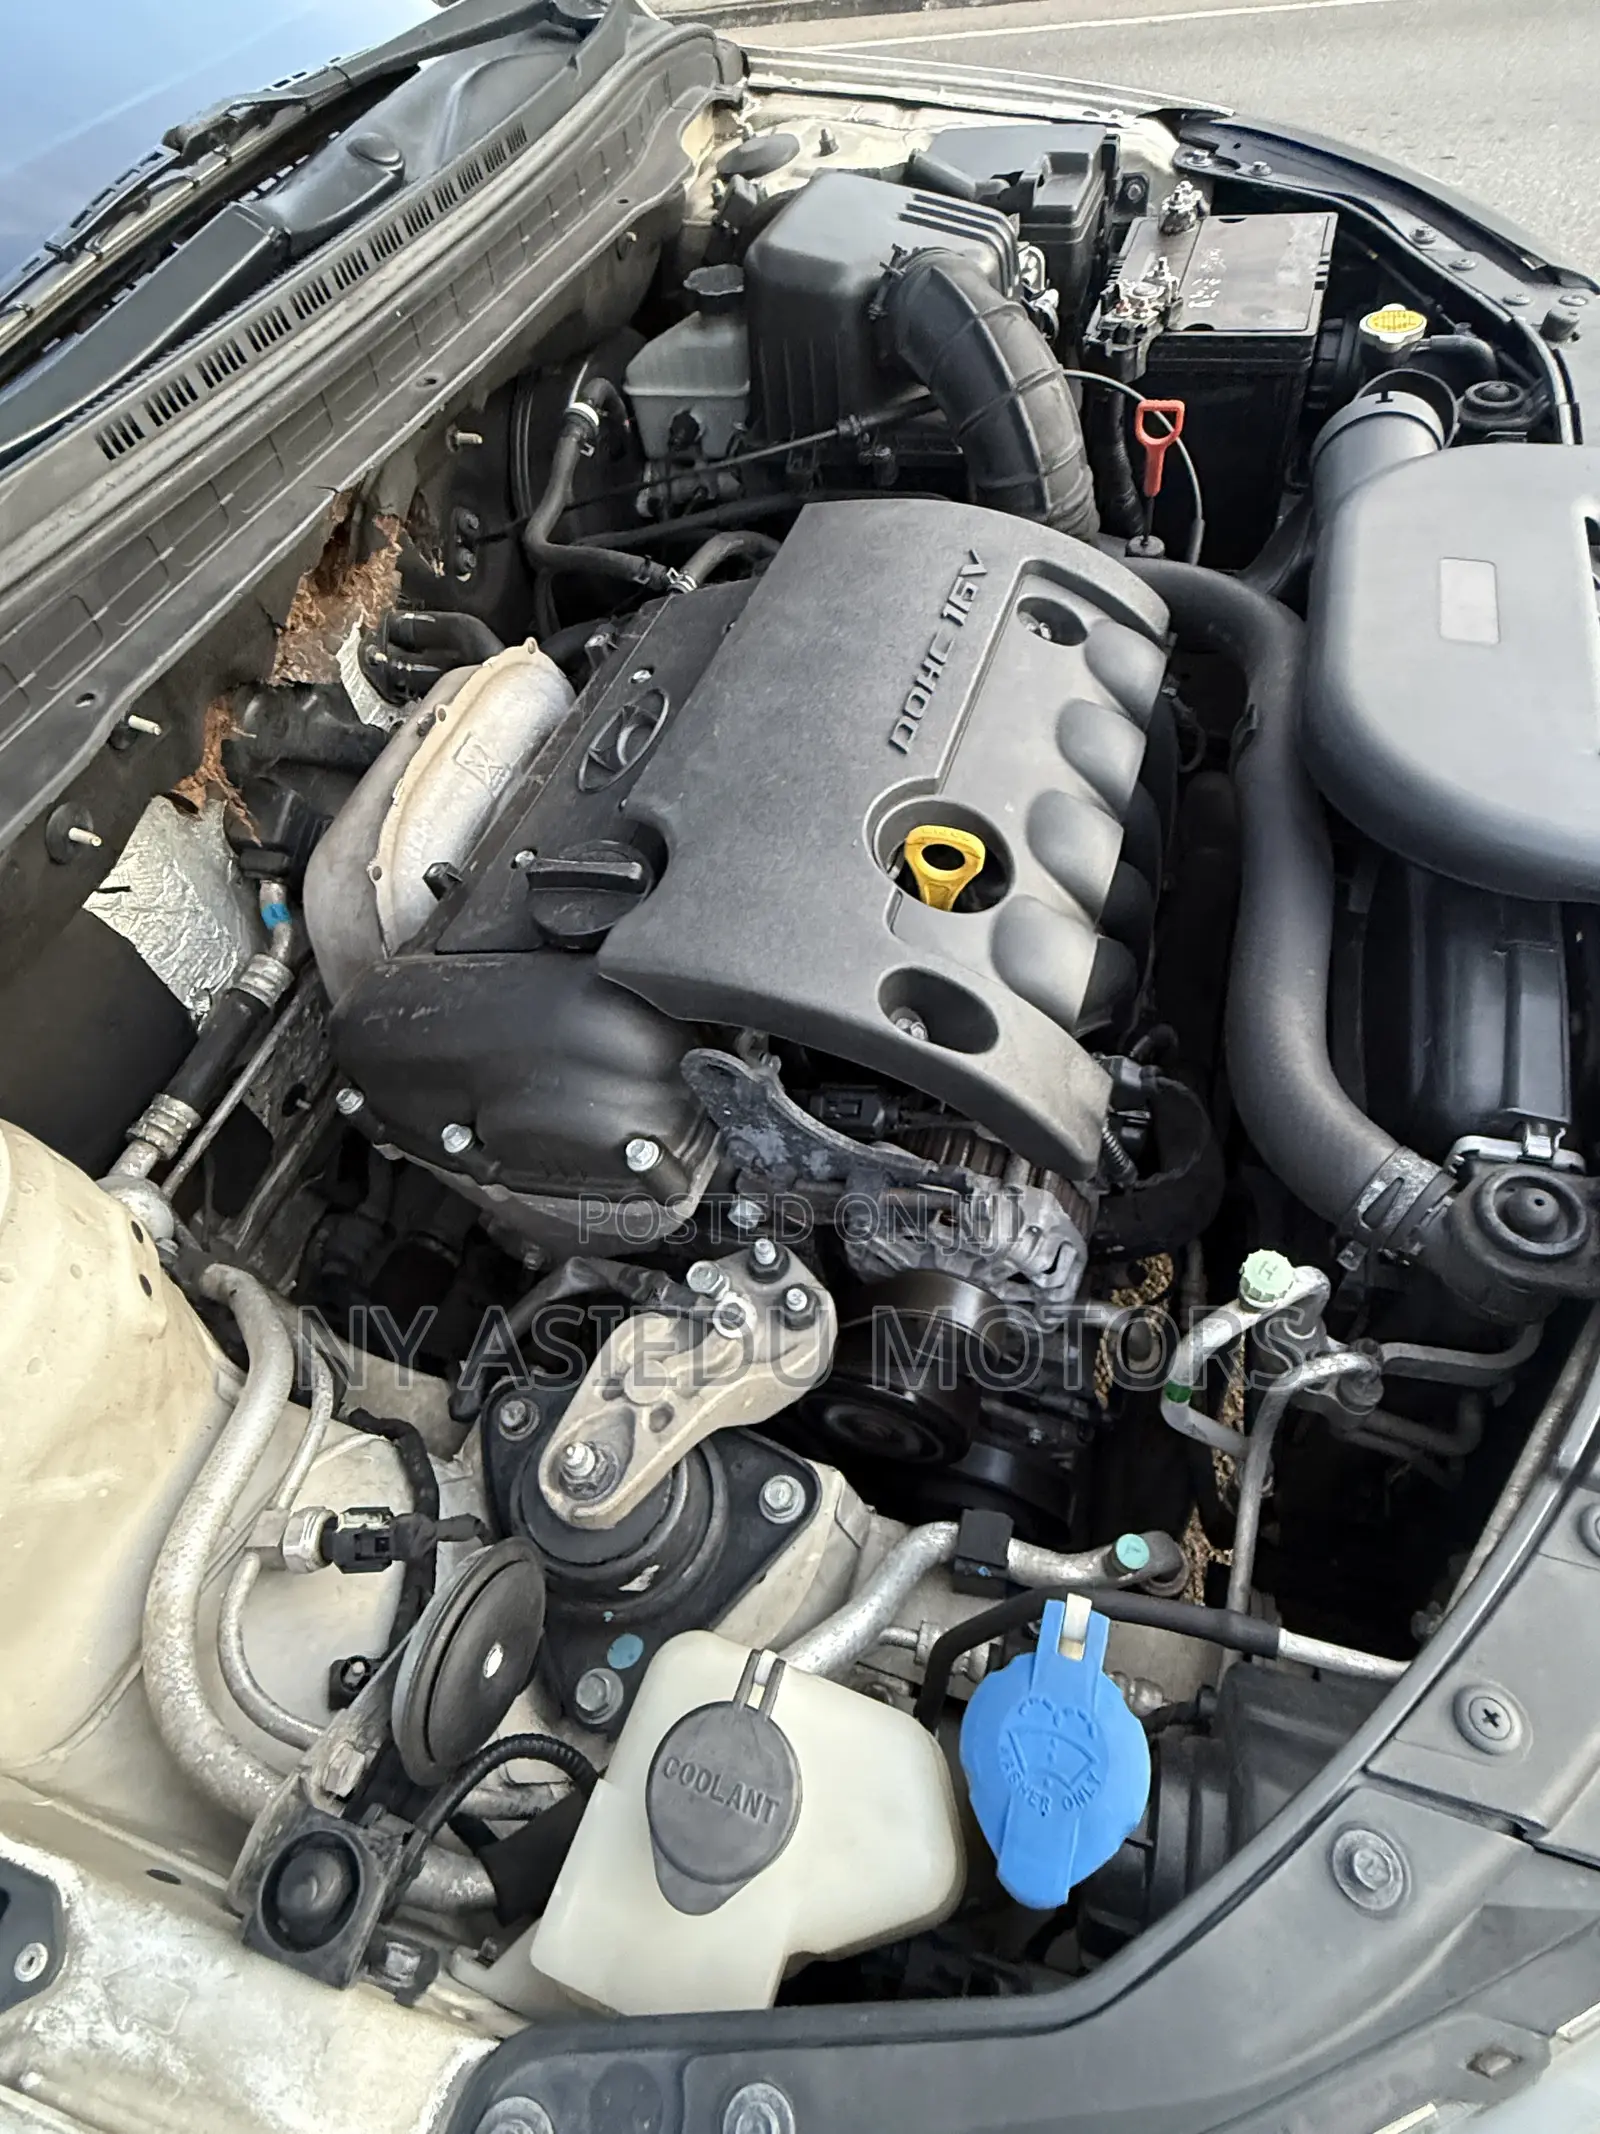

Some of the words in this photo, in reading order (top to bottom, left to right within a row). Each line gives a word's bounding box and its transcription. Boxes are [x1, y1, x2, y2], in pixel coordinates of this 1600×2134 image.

[889, 628, 956, 755] DOHC
[940, 549, 988, 627] 16V
[663, 1756, 782, 1824] COOLANT
[1062, 1769, 1102, 1812] ONLY
